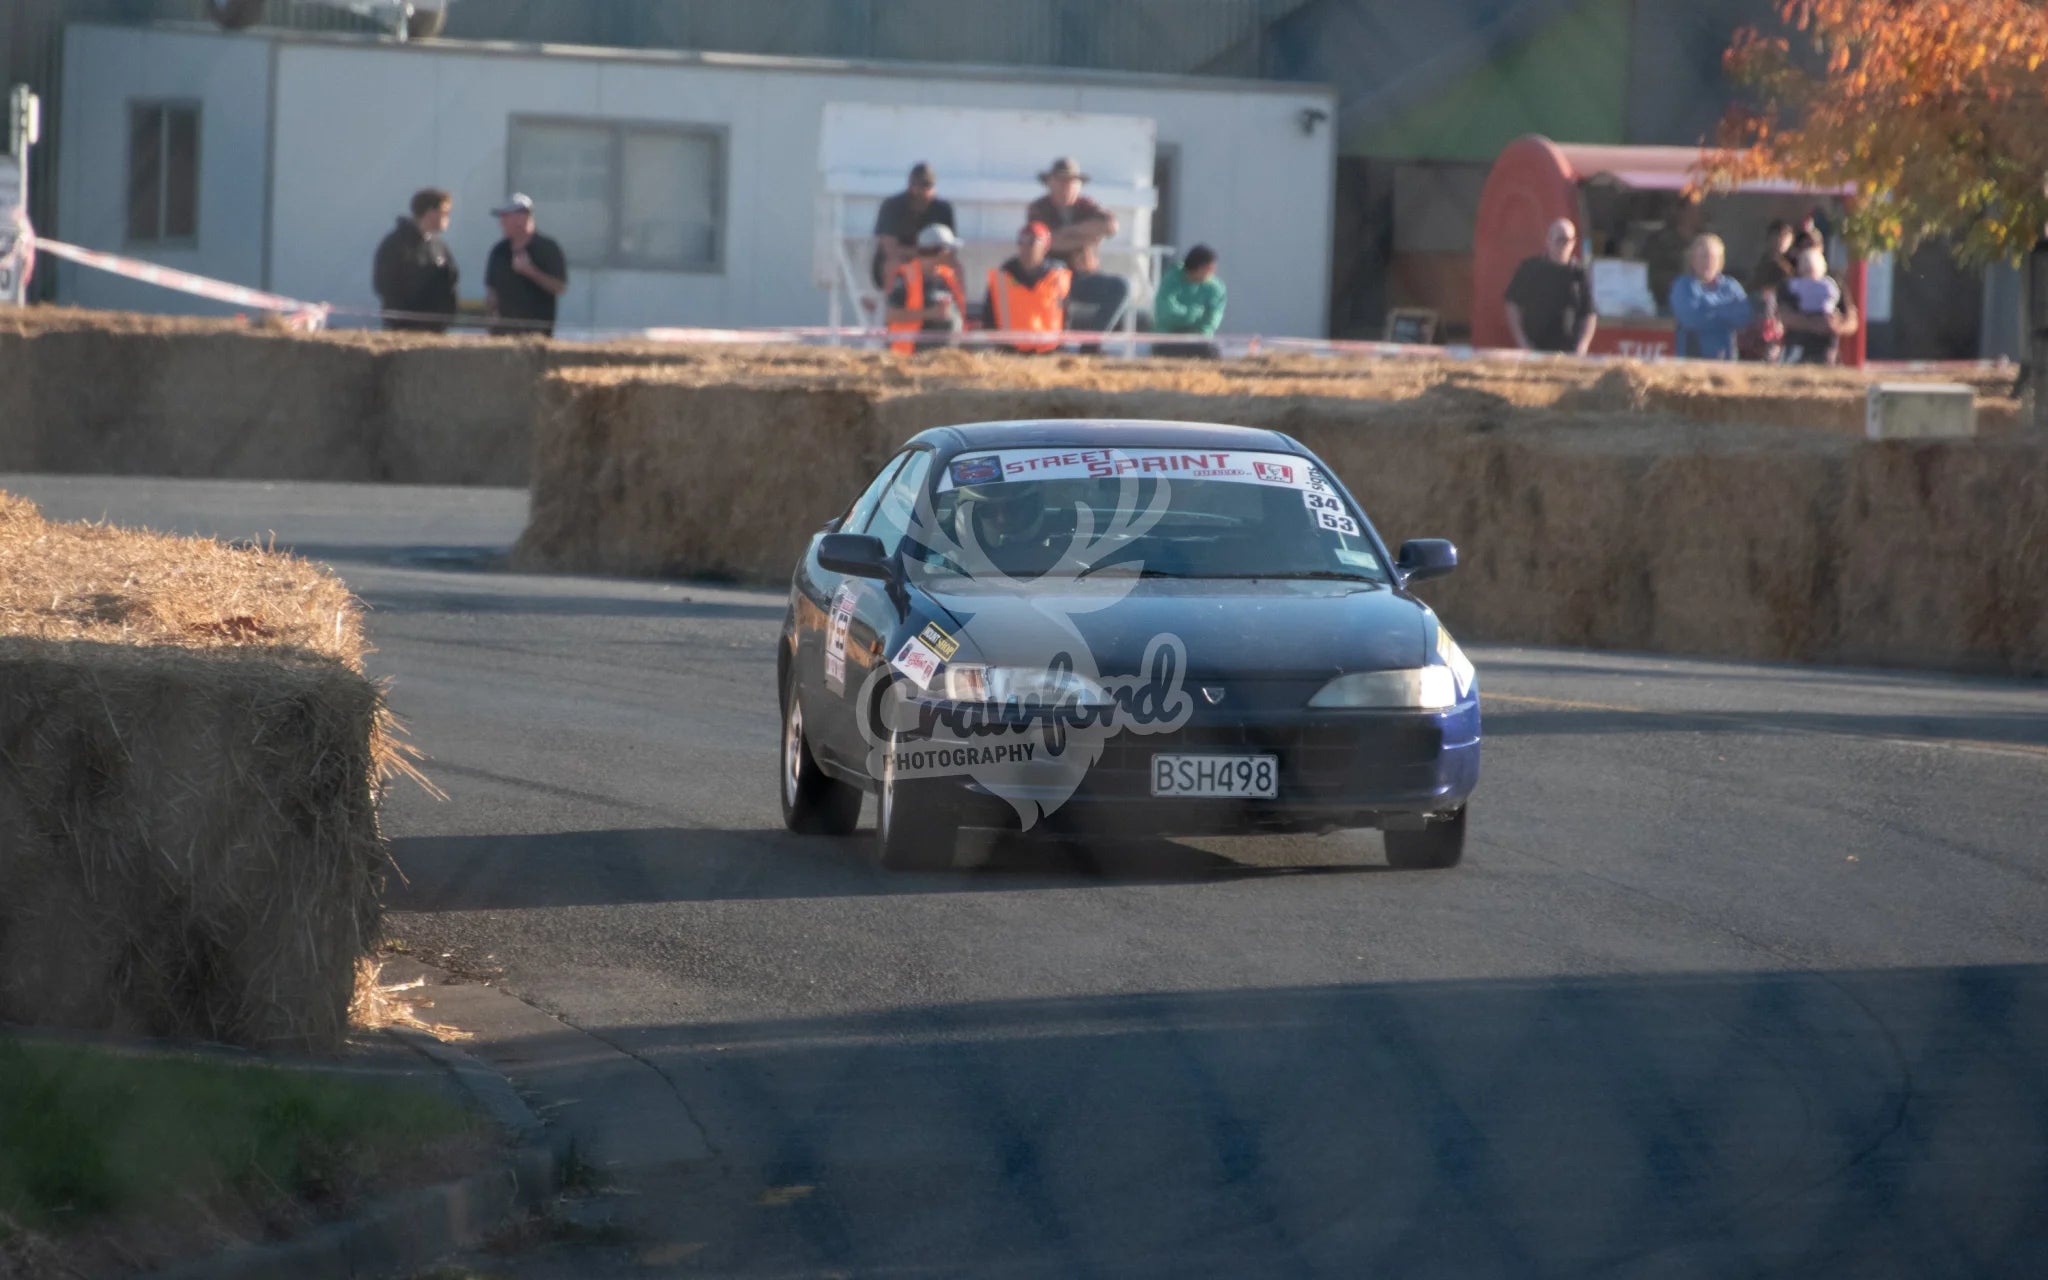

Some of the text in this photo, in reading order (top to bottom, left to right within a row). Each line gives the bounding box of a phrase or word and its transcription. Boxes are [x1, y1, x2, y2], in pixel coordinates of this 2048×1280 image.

[1005, 449, 1114, 475] STREET
[1087, 453, 1230, 479] SPRINT
[1308, 494, 1339, 511] 34
[1322, 513, 1354, 532] 53
[1157, 760, 1272, 792] BSH498
